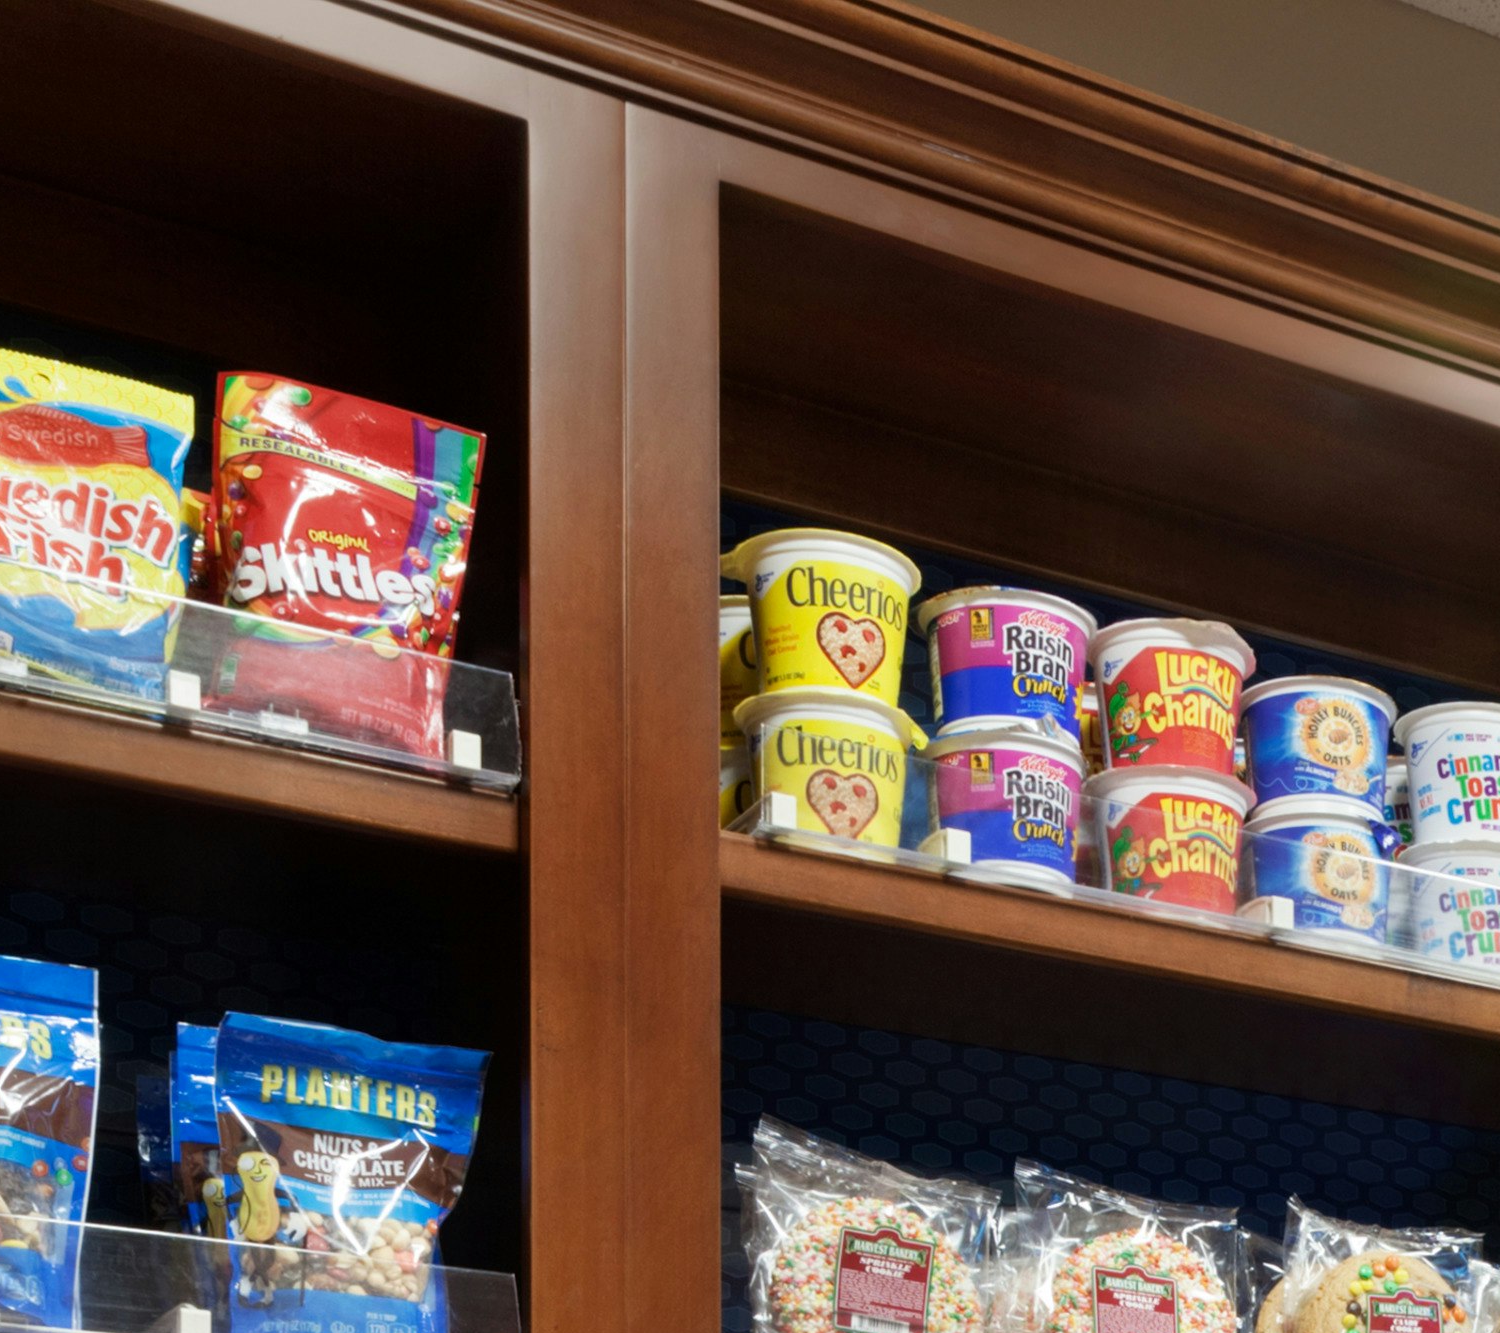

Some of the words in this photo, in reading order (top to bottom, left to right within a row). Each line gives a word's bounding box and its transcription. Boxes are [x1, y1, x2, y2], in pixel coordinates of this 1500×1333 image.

[8, 423, 99, 448] Swedish
[239, 436, 349, 472] RESEALABLE
[232, 541, 437, 617] Skittles
[786, 566, 904, 632] Cheerios
[1018, 610, 1070, 637] Kellogg's
[1006, 625, 1073, 664] Raisin
[1014, 652, 1068, 685] Bran
[1154, 650, 1236, 708] Lucky
[1012, 675, 1067, 705] Crunch
[1144, 691, 1236, 751] Charms
[1308, 708, 1329, 739] HONEY
[1332, 705, 1364, 746] BUNCHES
[776, 725, 898, 783] Cheerios
[1322, 752, 1351, 766] OATS
[261, 1064, 437, 1129] PLANTERS
[852, 1241, 888, 1257] HARVEST
[889, 1246, 919, 1262] BAKERY
[859, 1256, 912, 1275] SPRINKLE
[864, 1264, 905, 1279] COOKIE
